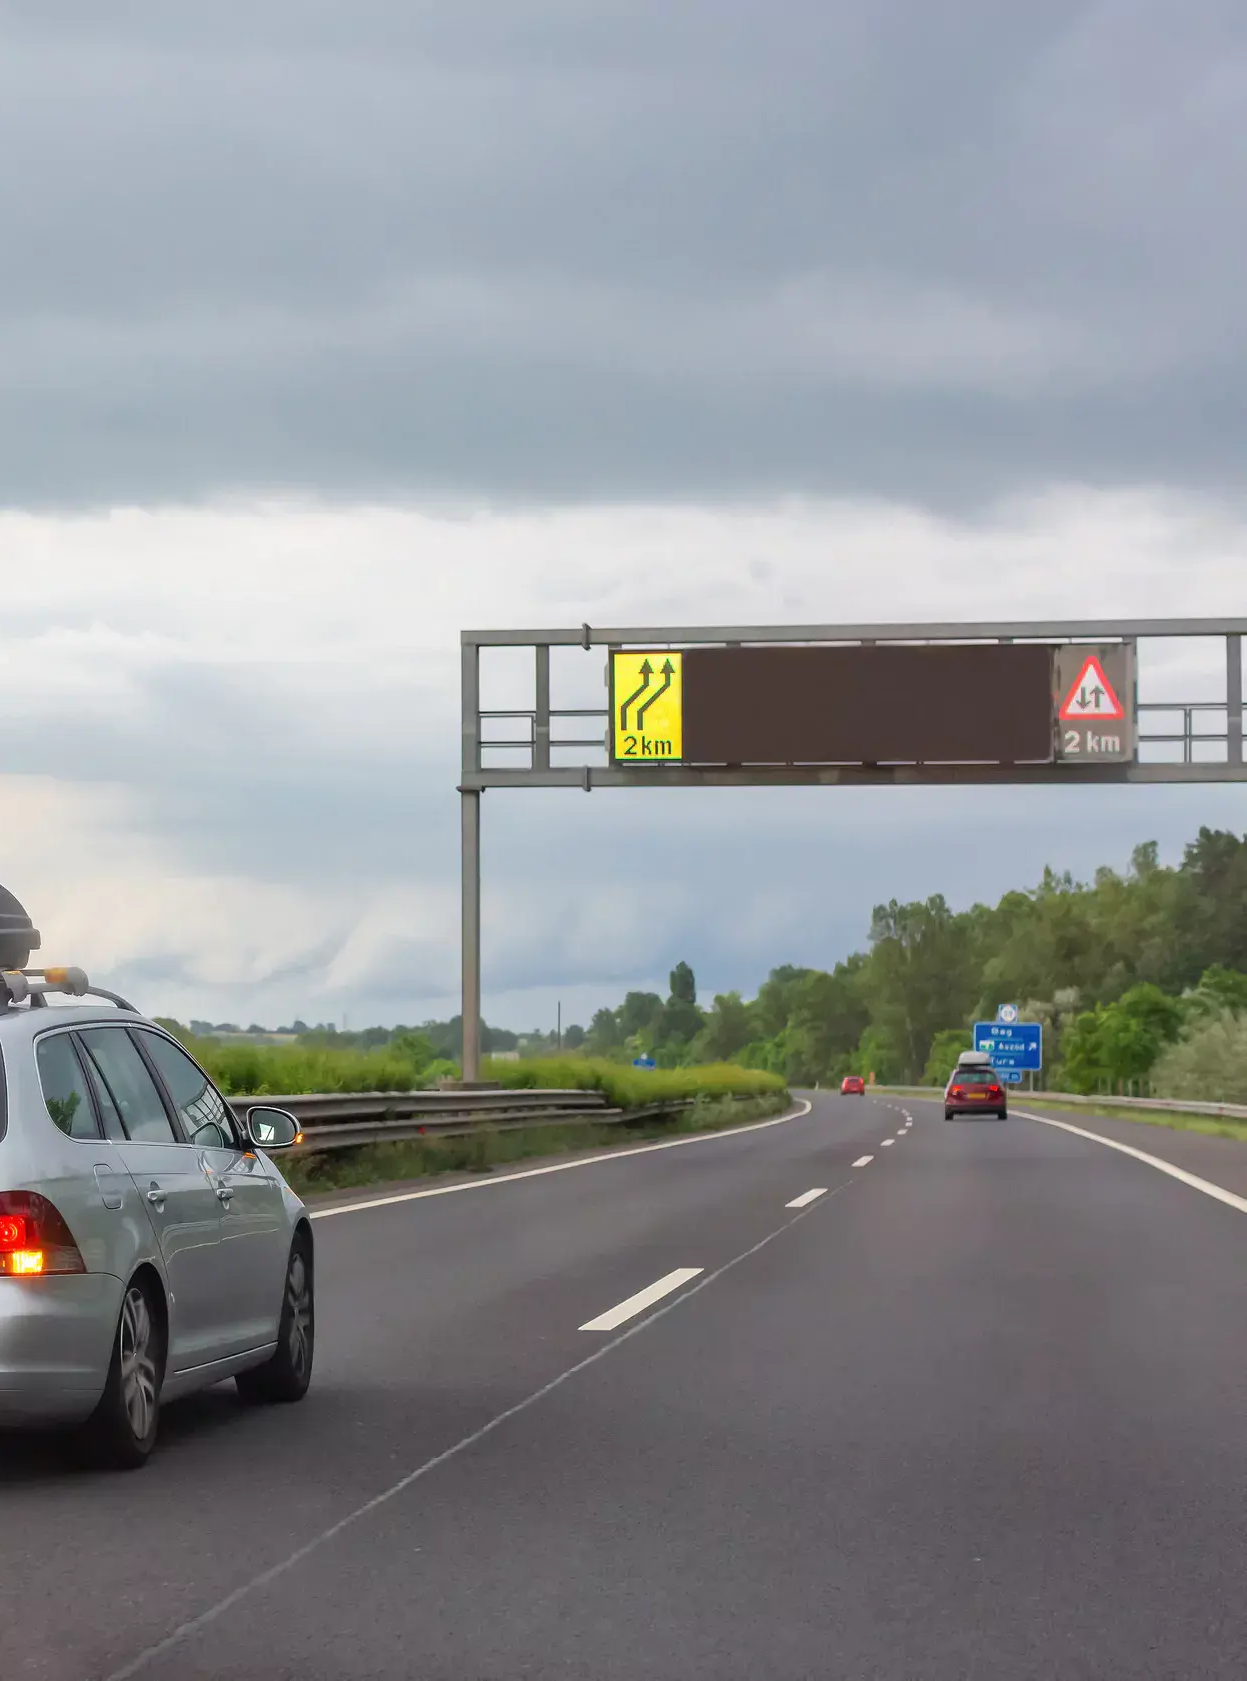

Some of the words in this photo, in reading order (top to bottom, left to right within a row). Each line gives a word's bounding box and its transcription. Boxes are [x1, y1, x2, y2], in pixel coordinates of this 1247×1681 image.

[624, 736, 637, 755] 2
[642, 736, 672, 755] km
[1064, 730, 1080, 753] 2
[1087, 731, 1120, 753] km
